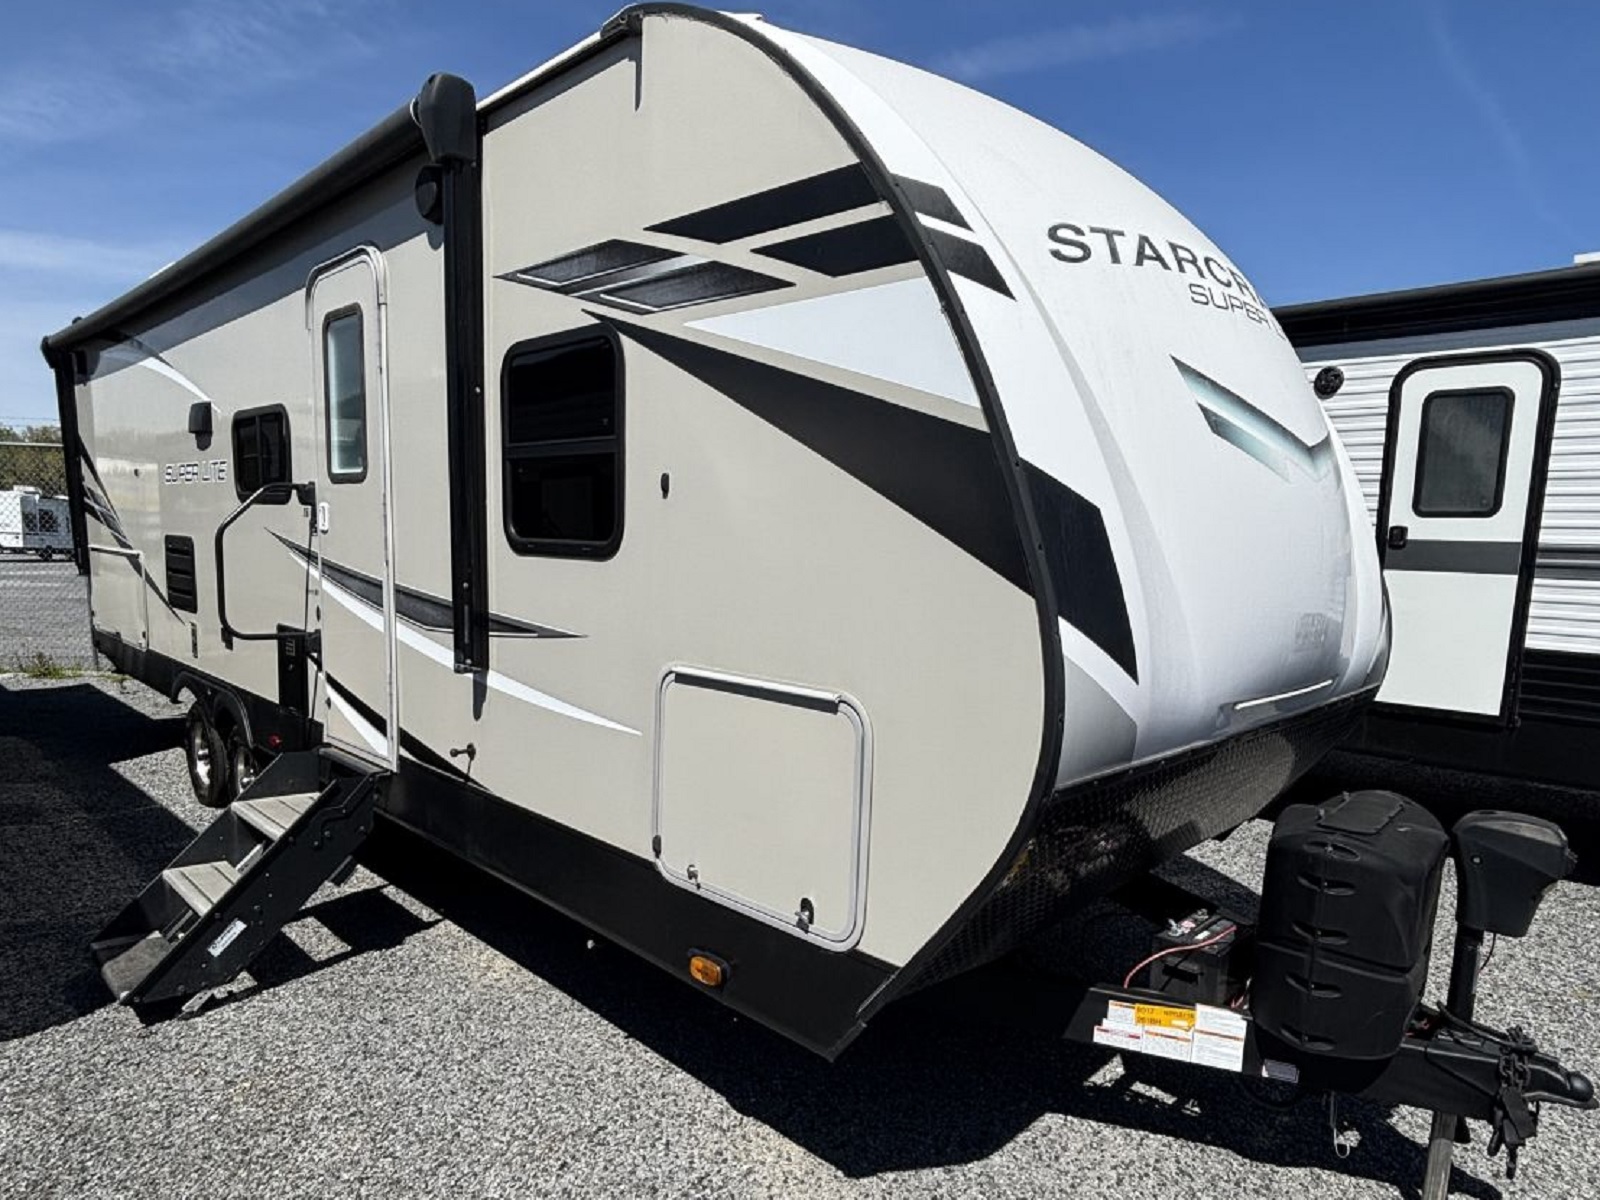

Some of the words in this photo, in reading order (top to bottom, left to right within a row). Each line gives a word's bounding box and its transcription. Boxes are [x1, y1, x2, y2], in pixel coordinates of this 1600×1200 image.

[1047, 222, 1265, 309] STARCR
[1188, 283, 1271, 329] SUPER
[165, 463, 199, 483] SUPER
[202, 460, 228, 482] LITE
